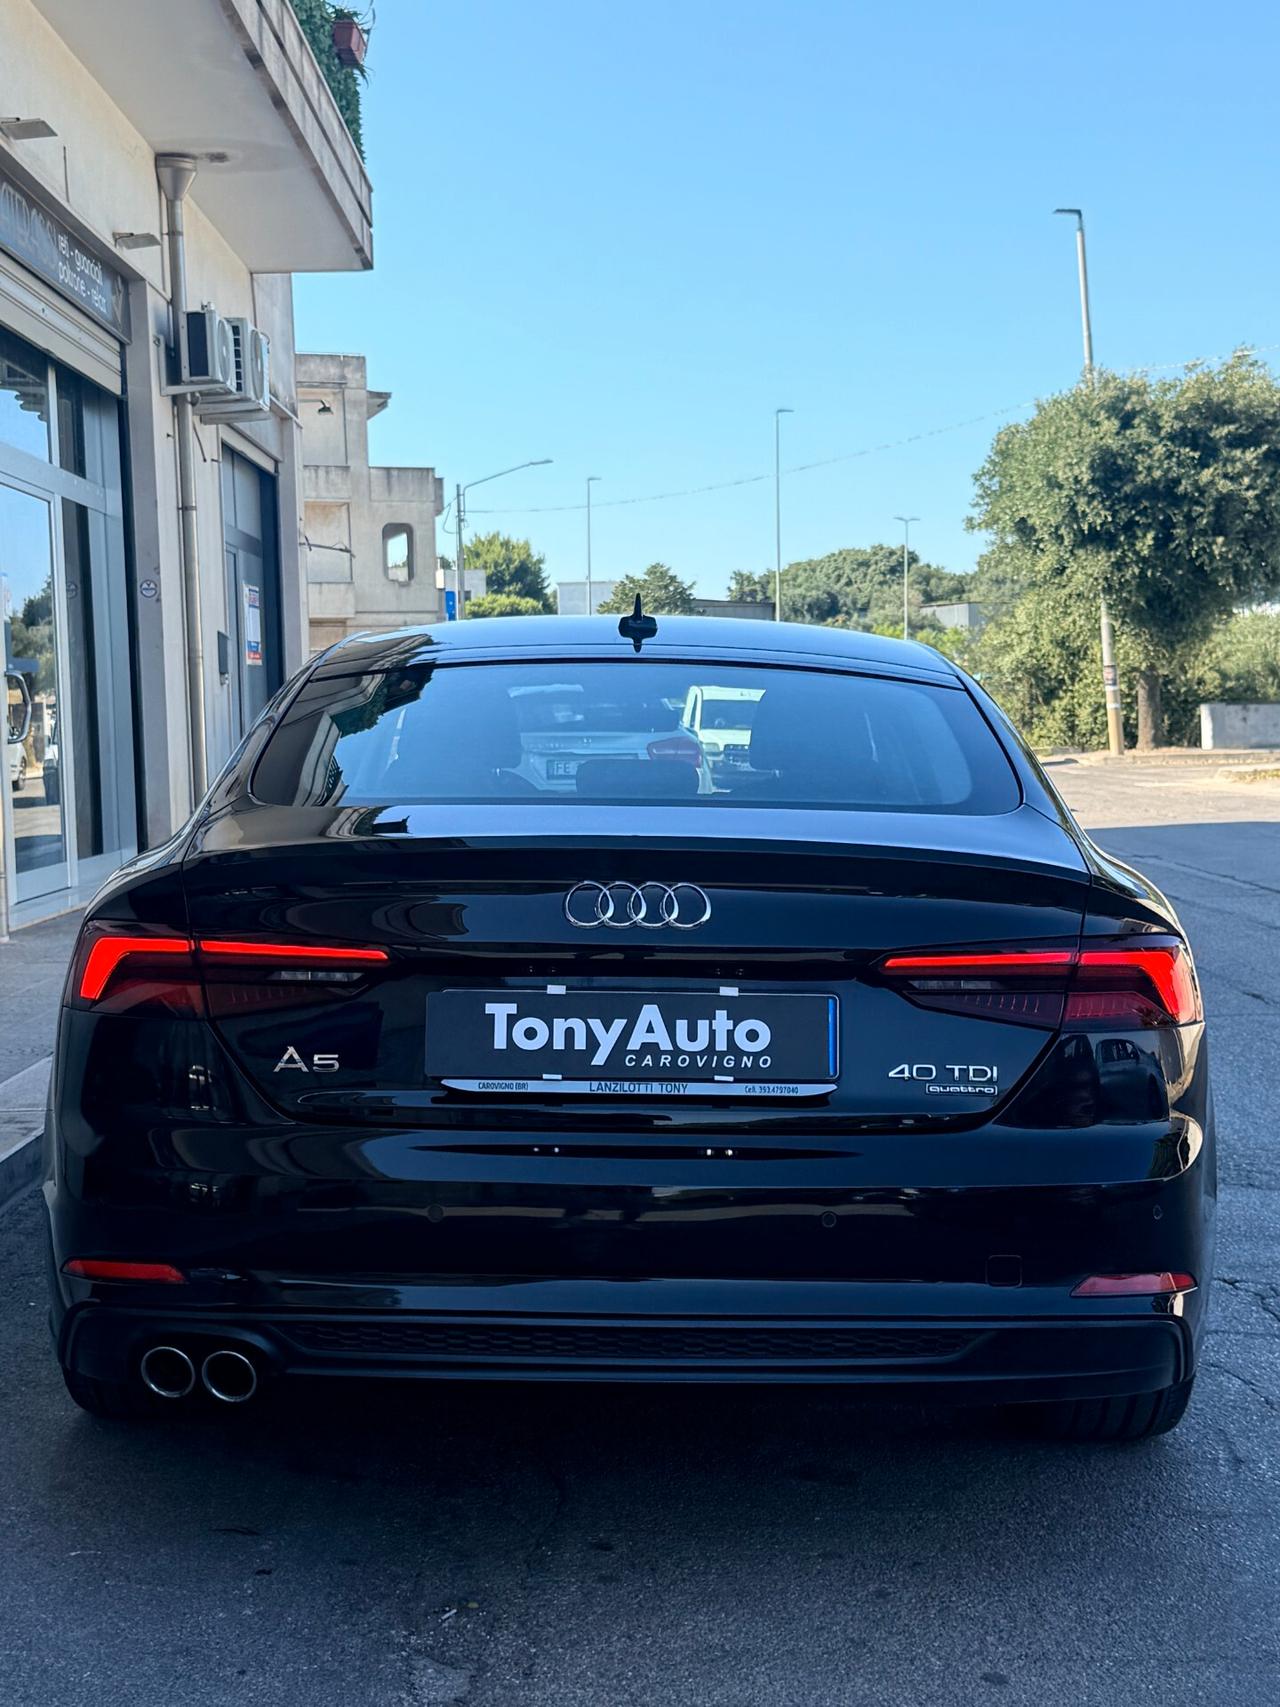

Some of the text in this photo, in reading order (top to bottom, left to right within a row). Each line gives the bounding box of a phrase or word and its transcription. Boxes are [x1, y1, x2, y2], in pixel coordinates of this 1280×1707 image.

[485, 1003, 771, 1066] TonyAuto
[273, 1046, 340, 1073] A5
[625, 1054, 771, 1068] CAROVIGNO
[888, 1064, 998, 1082] 40 TDI
[478, 1081, 529, 1091] CAROVIGNO (BR)
[589, 1081, 688, 1094] LANZILOTTI TONY
[929, 1085, 995, 1094] quattro
